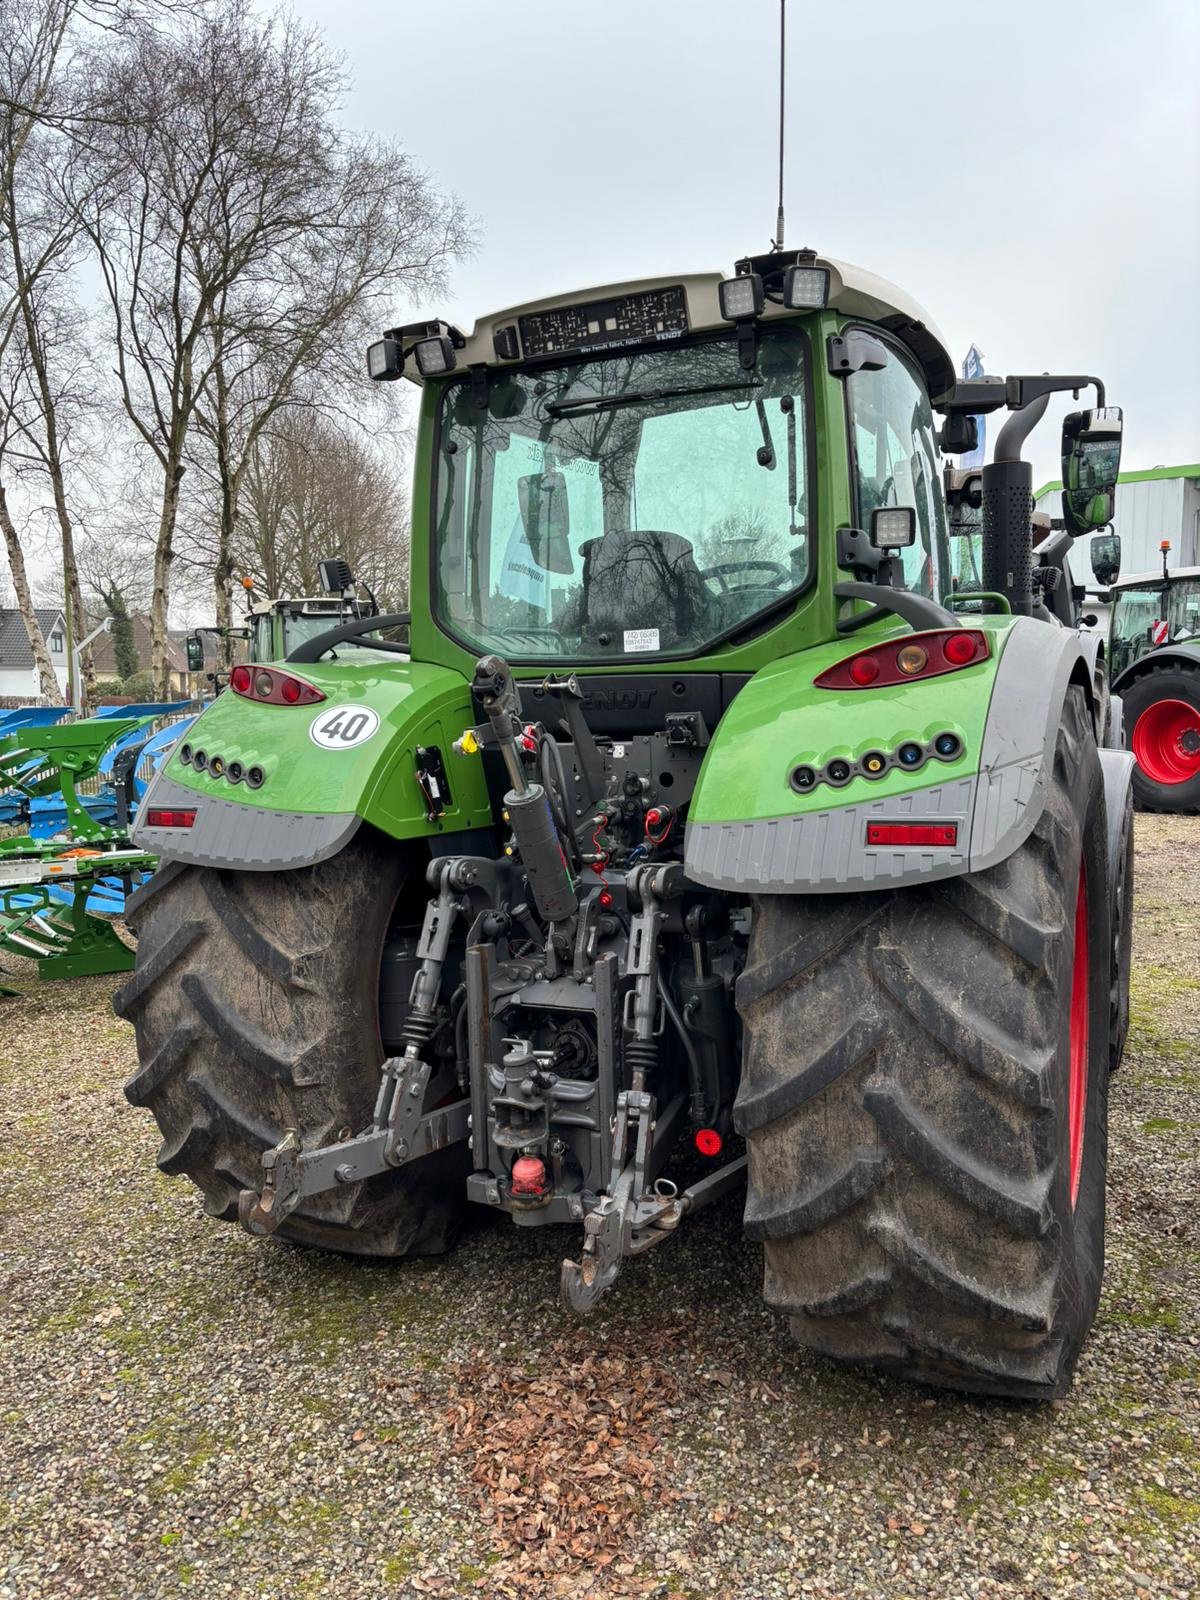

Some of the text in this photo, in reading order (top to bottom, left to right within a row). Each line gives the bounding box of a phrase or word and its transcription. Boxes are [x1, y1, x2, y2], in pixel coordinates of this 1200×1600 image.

[656, 330, 683, 341] FENDT
[579, 688, 657, 711] ENDT
[320, 710, 370, 742] 40
